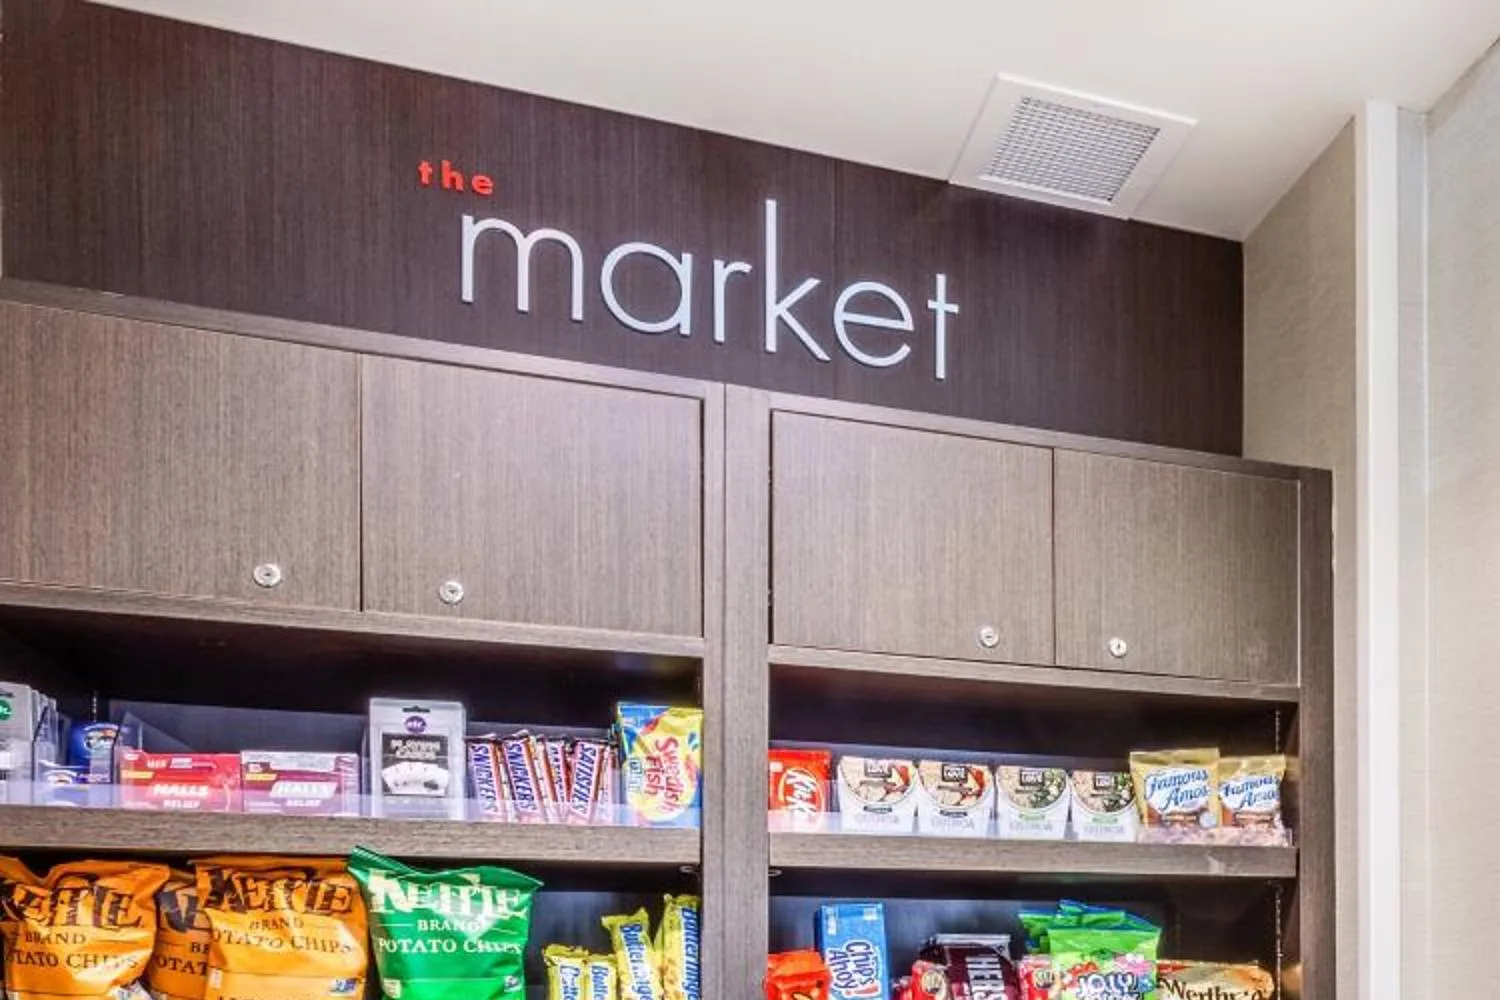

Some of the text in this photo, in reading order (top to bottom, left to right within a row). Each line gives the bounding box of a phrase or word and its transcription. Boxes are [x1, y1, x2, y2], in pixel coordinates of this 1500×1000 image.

[417, 160, 494, 195] the
[461, 199, 960, 380] market
[507, 742, 538, 812] SNICKERS
[643, 752, 665, 797] Fish
[1146, 768, 1209, 800] Famous
[1162, 785, 1210, 812] Amos
[417, 919, 485, 933] BRAND
[378, 939, 457, 954] POTATO
[846, 940, 876, 992] Chips
[1078, 971, 1135, 998] JOLLY
